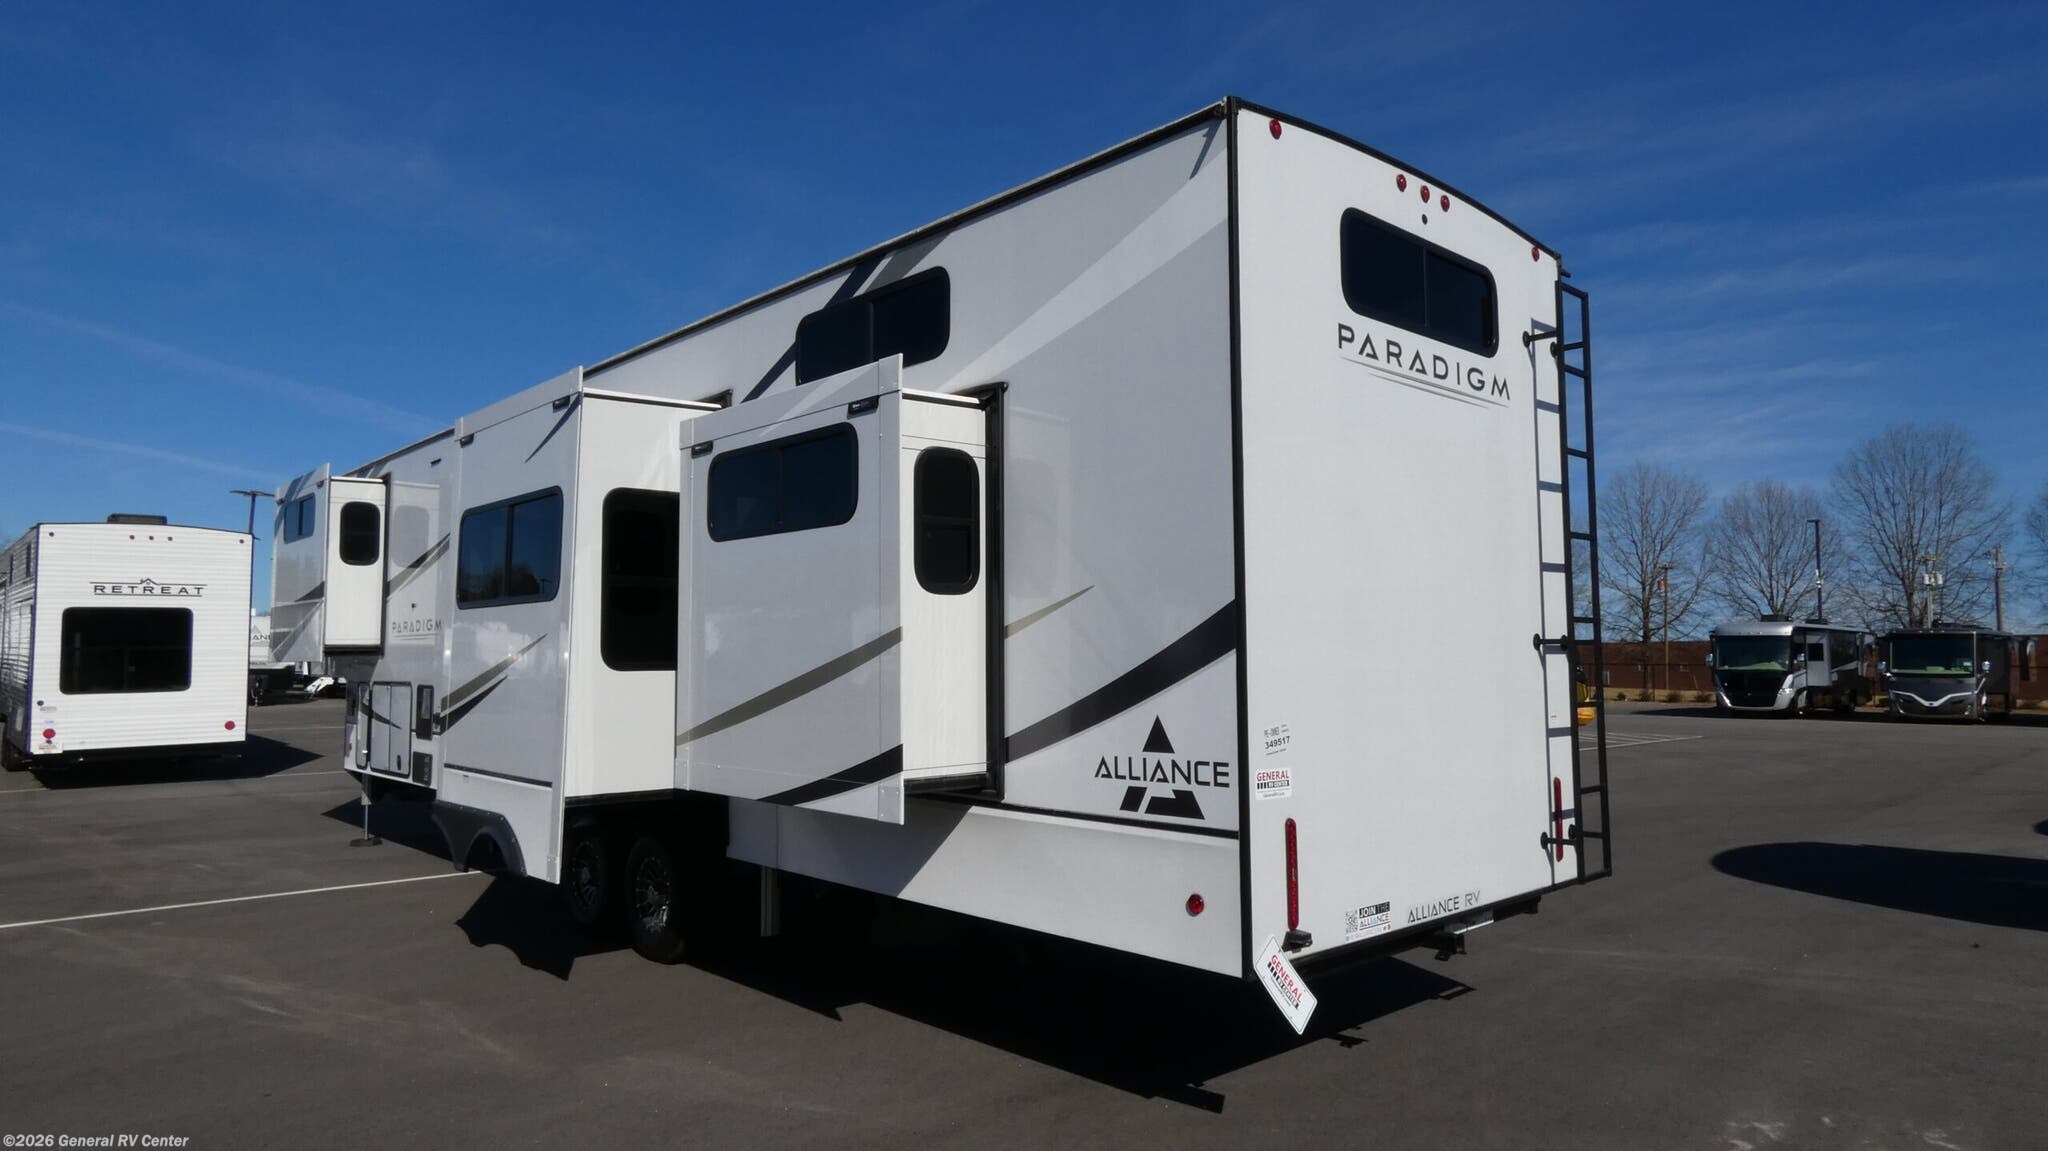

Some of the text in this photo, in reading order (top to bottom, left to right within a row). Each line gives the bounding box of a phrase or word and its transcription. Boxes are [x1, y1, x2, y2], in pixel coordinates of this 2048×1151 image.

[1337, 322, 1511, 401] PARADIGM
[93, 584, 205, 595] RETREAT
[392, 618, 442, 633] PARADIGM
[1264, 735, 1291, 750] 349517
[1094, 755, 1231, 789] ALLIANCE
[1256, 769, 1290, 782] GENERAL
[1359, 904, 1376, 919] JOIN
[1407, 890, 1481, 924] ALLIANCE RV
[1271, 954, 1303, 1003] GENERAL
